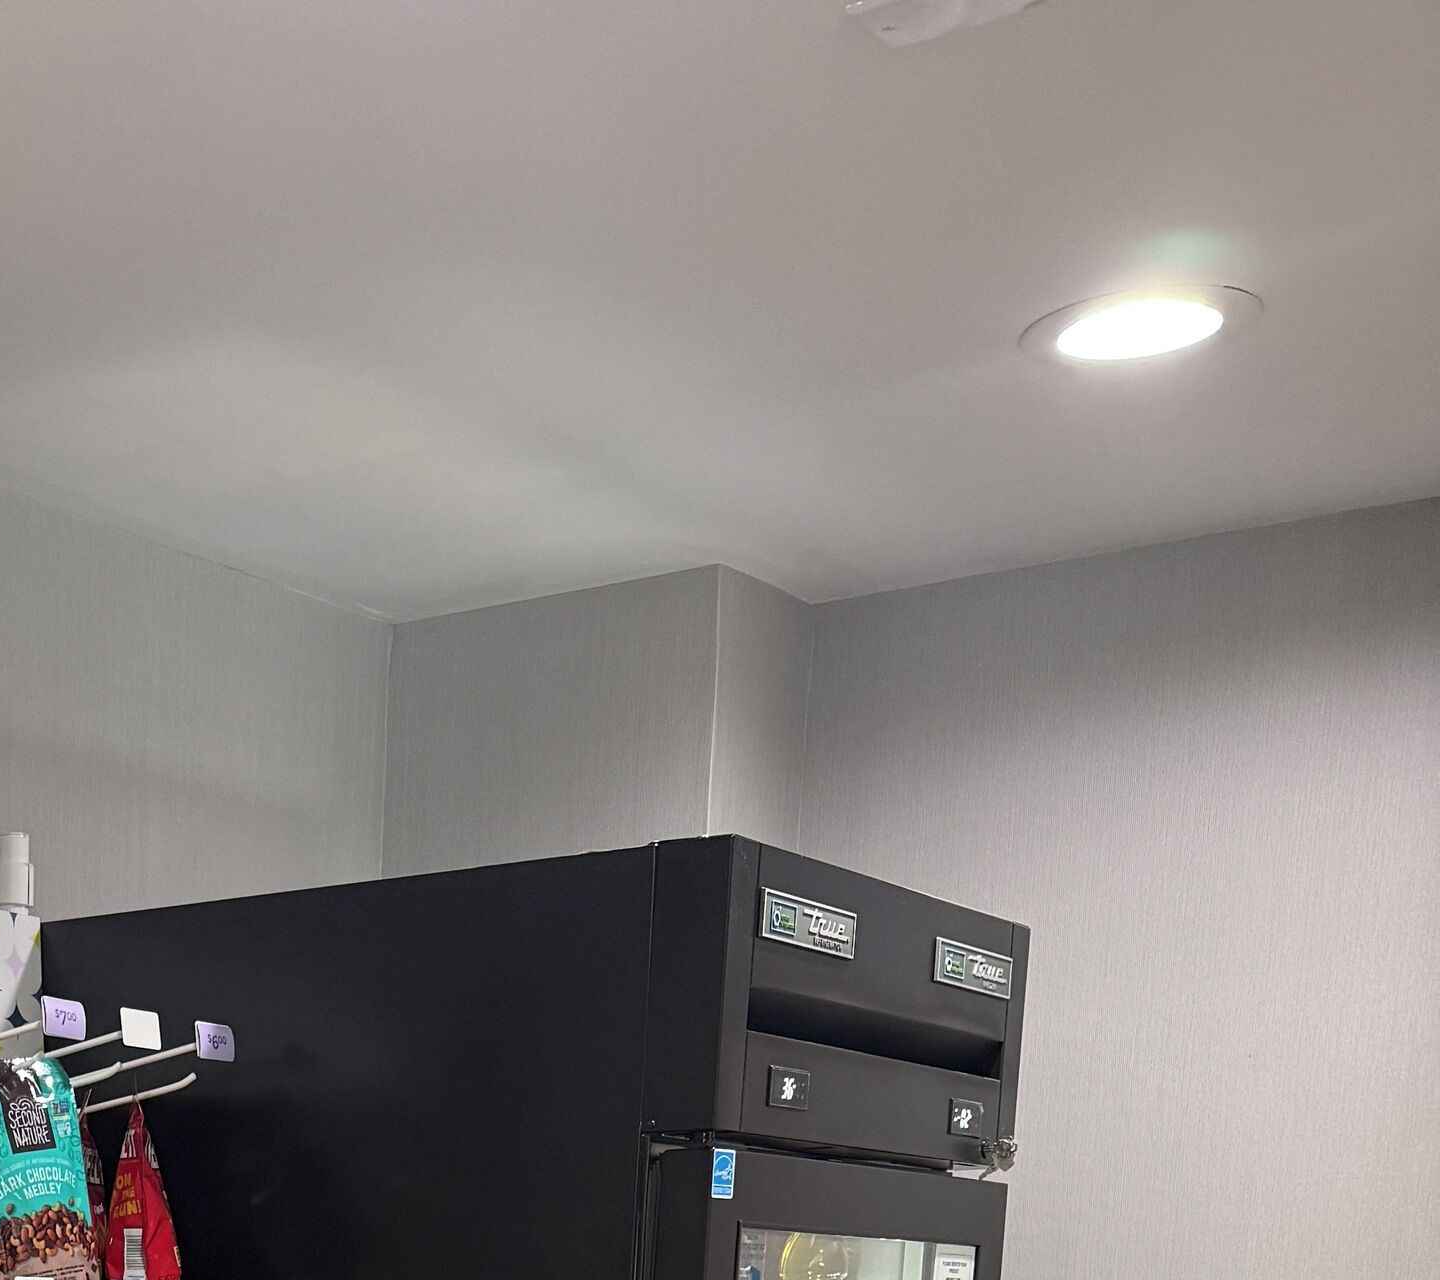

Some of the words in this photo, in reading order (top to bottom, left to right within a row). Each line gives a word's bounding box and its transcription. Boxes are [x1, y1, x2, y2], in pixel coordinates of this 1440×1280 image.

[7, 1102, 48, 1130] SECOND
[13, 1125, 51, 1149] NATURE
[27, 1166, 76, 1189] CHOCOLATE
[24, 1182, 63, 1200] MEDLEY
